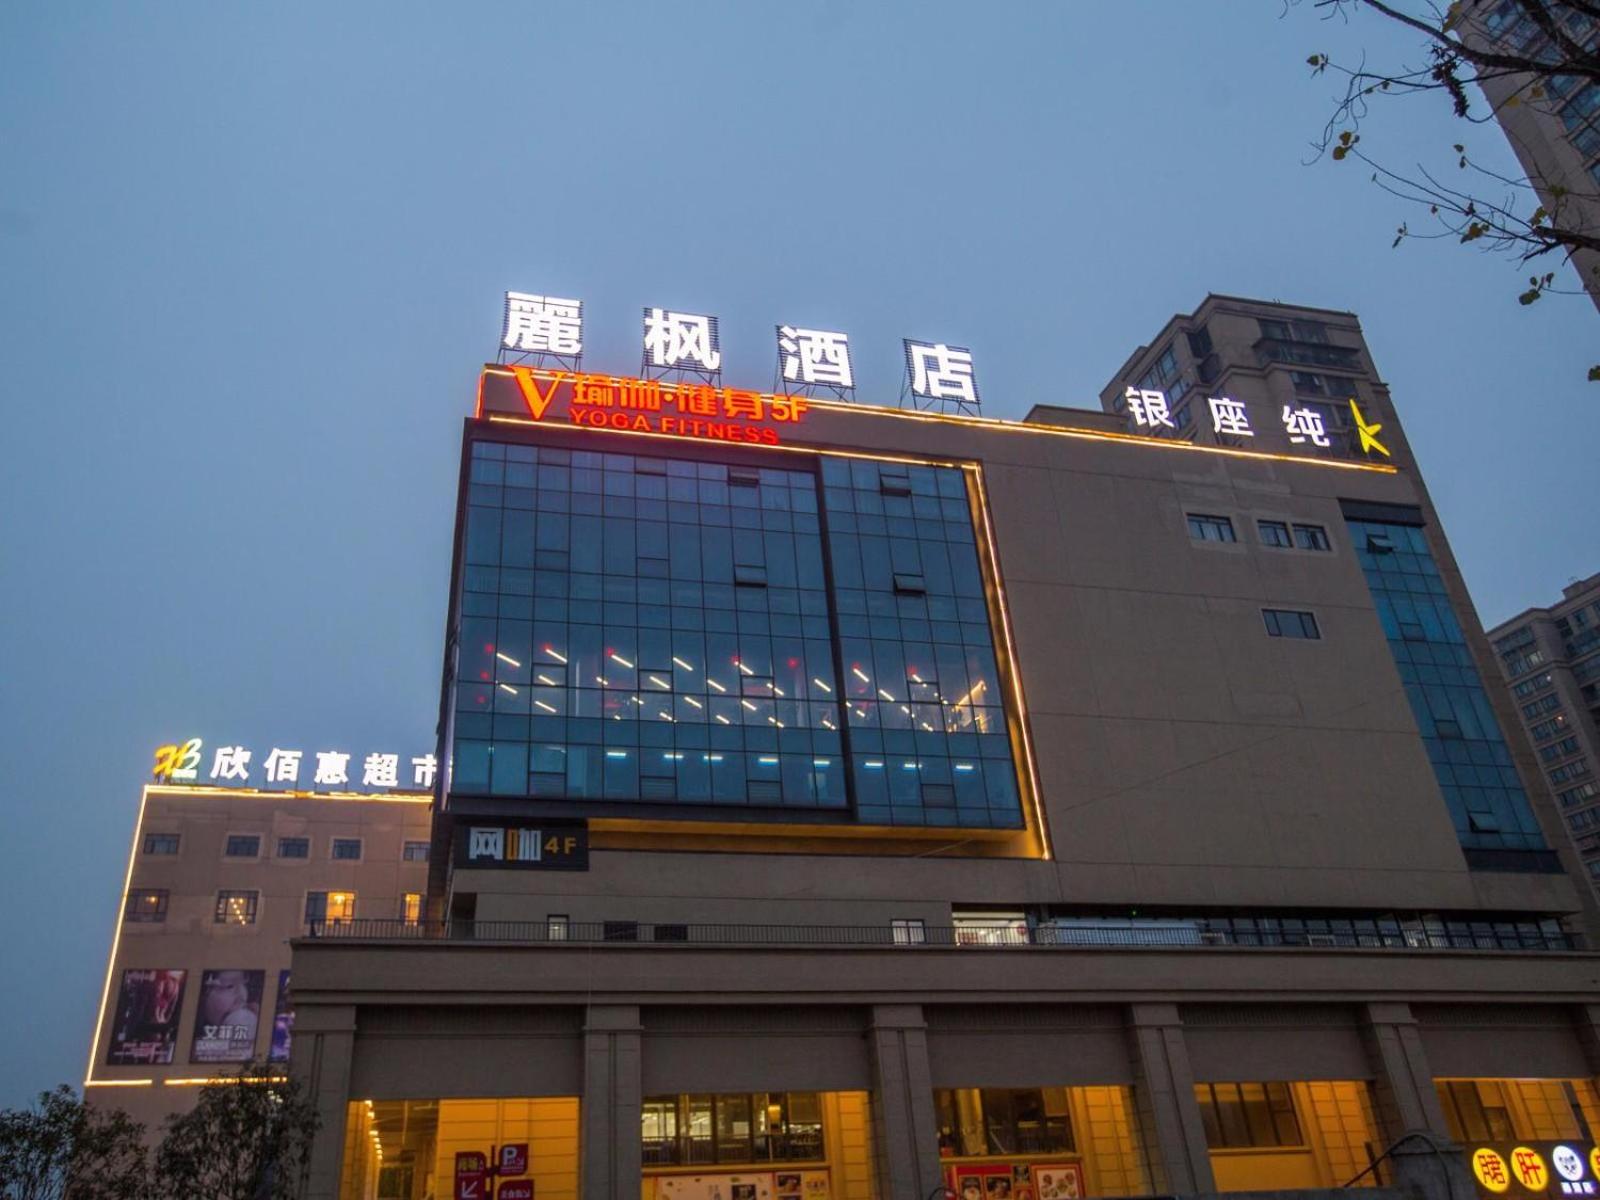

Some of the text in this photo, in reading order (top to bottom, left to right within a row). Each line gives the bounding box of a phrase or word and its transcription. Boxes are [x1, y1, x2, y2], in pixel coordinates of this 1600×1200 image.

[770, 395, 808, 422] 5F
[569, 407, 780, 445] YOGA FITNESS
[210, 746, 437, 787] 欣佰惠超市
[544, 837, 577, 854] 4F
[502, 1147, 517, 1166] P
